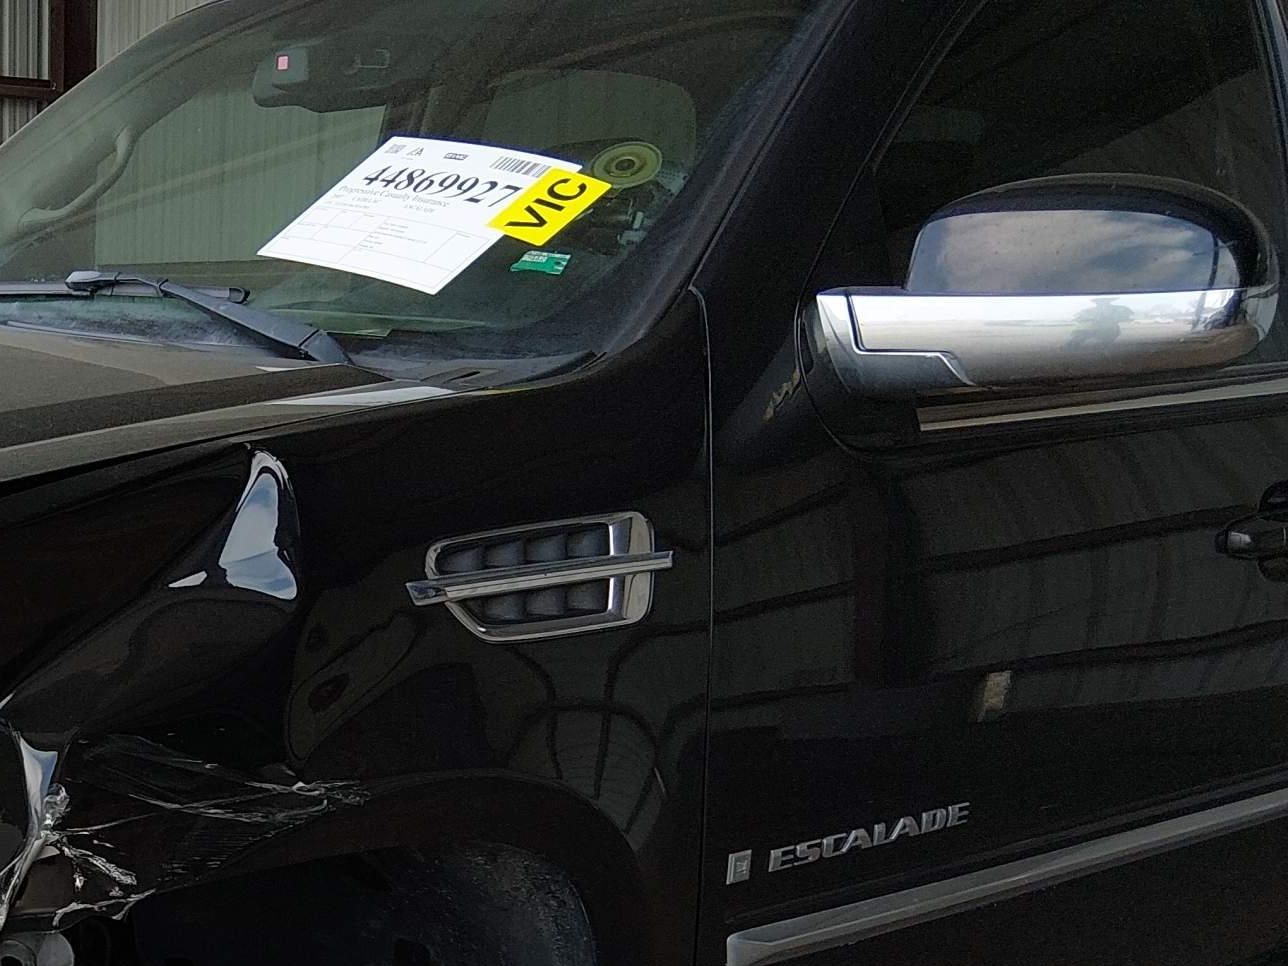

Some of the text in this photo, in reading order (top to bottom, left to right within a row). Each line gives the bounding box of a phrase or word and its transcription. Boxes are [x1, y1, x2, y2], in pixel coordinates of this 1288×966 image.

[363, 164, 523, 208] 44869927
[503, 177, 588, 228] VIC
[768, 802, 970, 872] ESCALADE
